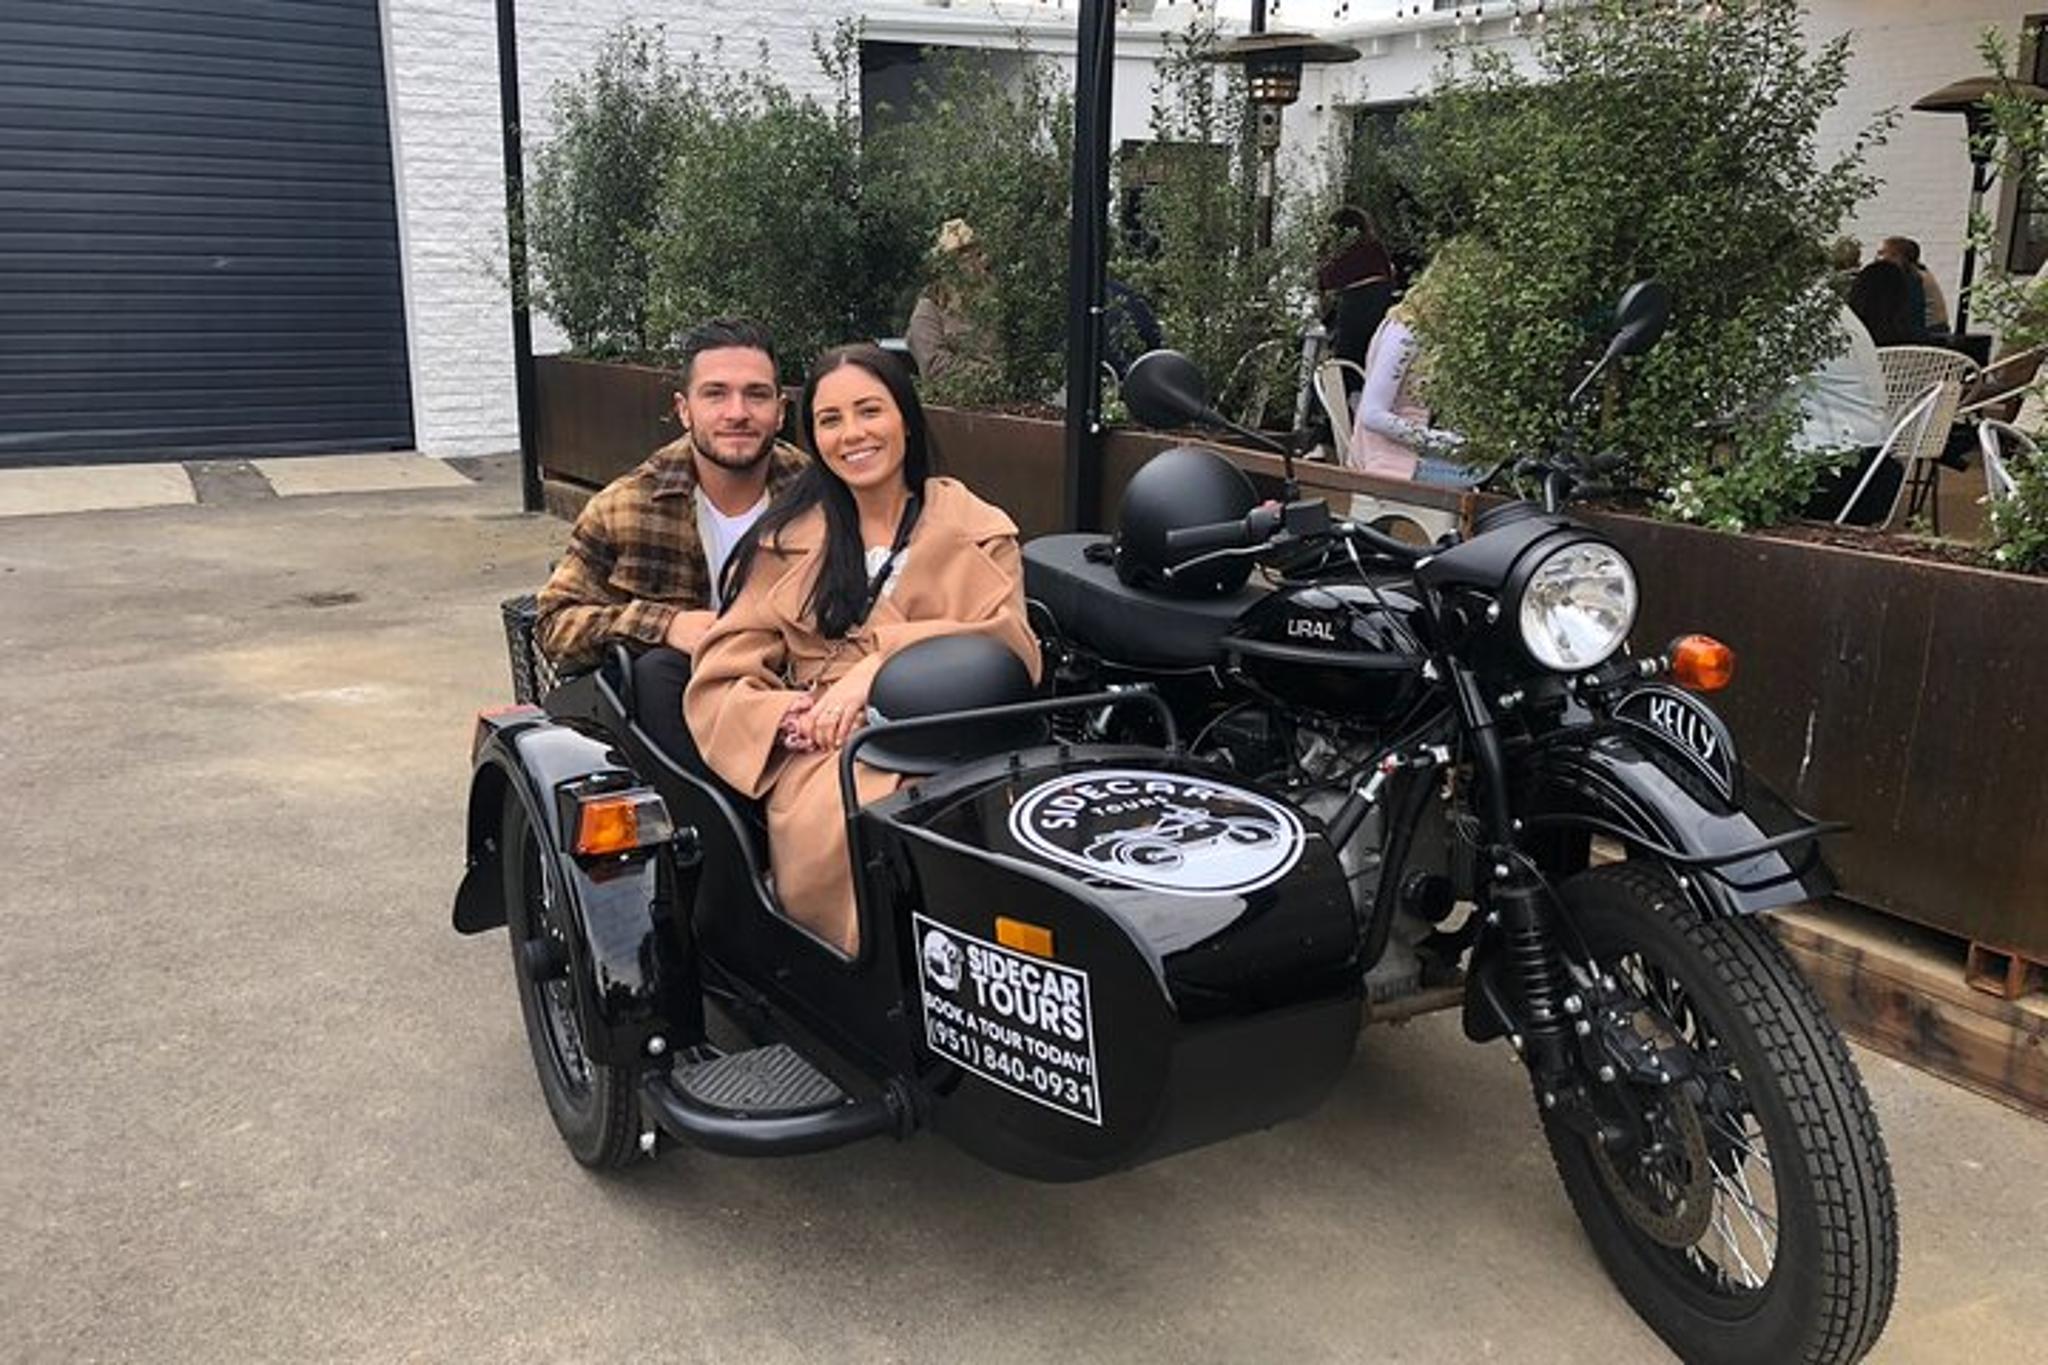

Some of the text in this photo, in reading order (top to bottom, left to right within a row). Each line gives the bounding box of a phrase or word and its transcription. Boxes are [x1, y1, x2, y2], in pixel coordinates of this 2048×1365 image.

[1287, 619, 1336, 641] URAL
[1649, 696, 1717, 760] KELLY
[1040, 779, 1216, 829] SIDECAR
[966, 943, 1081, 1007] SIDECAR
[970, 971, 1084, 1042] TOURS
[924, 991, 1092, 1076] BOOK A TOUR TODAY!
[930, 1018, 1094, 1110] (951) 840-0931
